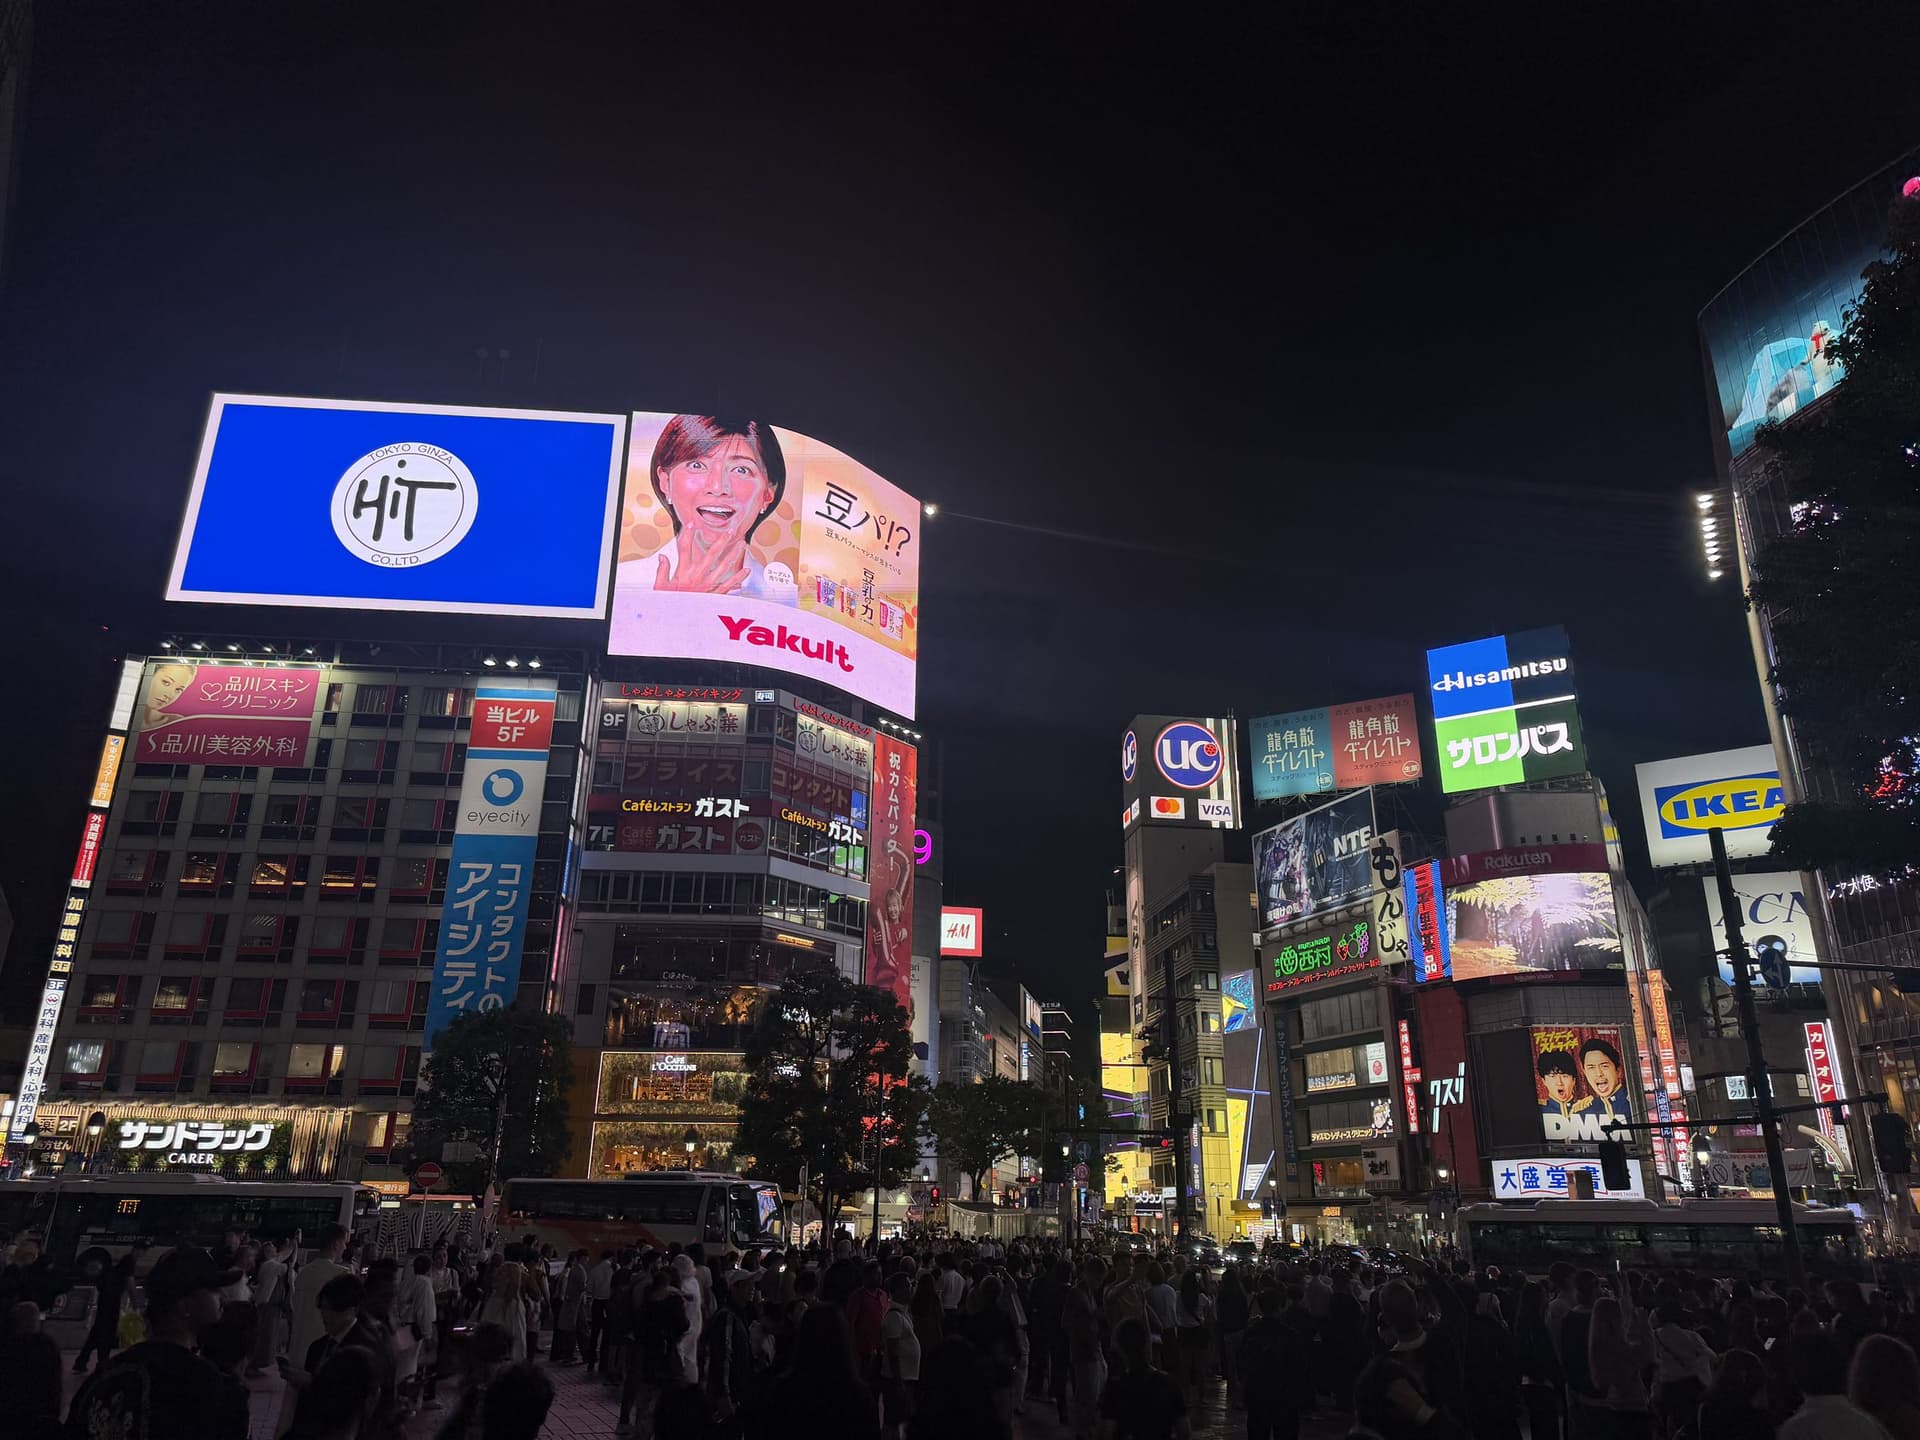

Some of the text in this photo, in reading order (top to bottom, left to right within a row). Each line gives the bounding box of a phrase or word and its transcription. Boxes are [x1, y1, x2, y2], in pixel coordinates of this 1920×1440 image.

[367, 443, 453, 465] TOKYO GINZA
[718, 614, 855, 673] Yakult
[224, 675, 311, 694] 品川スキン
[1433, 656, 1568, 693] Hisamitsu
[222, 694, 299, 711] クリニック
[620, 684, 744, 701] しゃぶしゃぶバイキング
[485, 705, 541, 725] 当ビル
[603, 712, 625, 727] 9F
[670, 711, 739, 734] しゃぶ葉
[793, 697, 873, 737] しゃぶしゃぶバイキング
[1348, 712, 1401, 741] 龍角散
[160, 733, 298, 758] 品川美容外科
[496, 725, 525, 743] 5F
[1266, 725, 1315, 753] 龍角散
[1446, 721, 1575, 769] サロンパス
[821, 733, 868, 768] しゃぶ葉
[1343, 734, 1412, 763] ダイレクト
[1261, 748, 1326, 774] ダイレクト
[466, 808, 531, 829] eyecity
[694, 796, 751, 818] ガスト
[1201, 804, 1231, 816] VISA
[588, 825, 615, 842] 7F
[655, 823, 725, 851] ガスト
[739, 834, 761, 842] ガスト
[827, 819, 864, 845] ガスト
[1333, 825, 1371, 857] NTE
[1485, 851, 1552, 870] Rakuten
[1372, 837, 1408, 958] もんじゃ
[443, 863, 492, 1014] アイシティ
[478, 863, 521, 1014] コンタクトの
[946, 922, 971, 940] H&M
[53, 962, 69, 970] 5F
[1299, 945, 1331, 972] 西村
[48, 981, 64, 990] 3F
[39, 1008, 56, 1029] 内科
[1650, 973, 1668, 1044] クスリのことなら
[1810, 1031, 1833, 1094] カラオケ
[1430, 1061, 1465, 1133] クスリ
[40, 1117, 56, 1133] 薬
[58, 1120, 78, 1132] 2F
[119, 1122, 276, 1151] サンドラッグ
[40, 1151, 61, 1164] 受付
[168, 1152, 215, 1165] CARER
